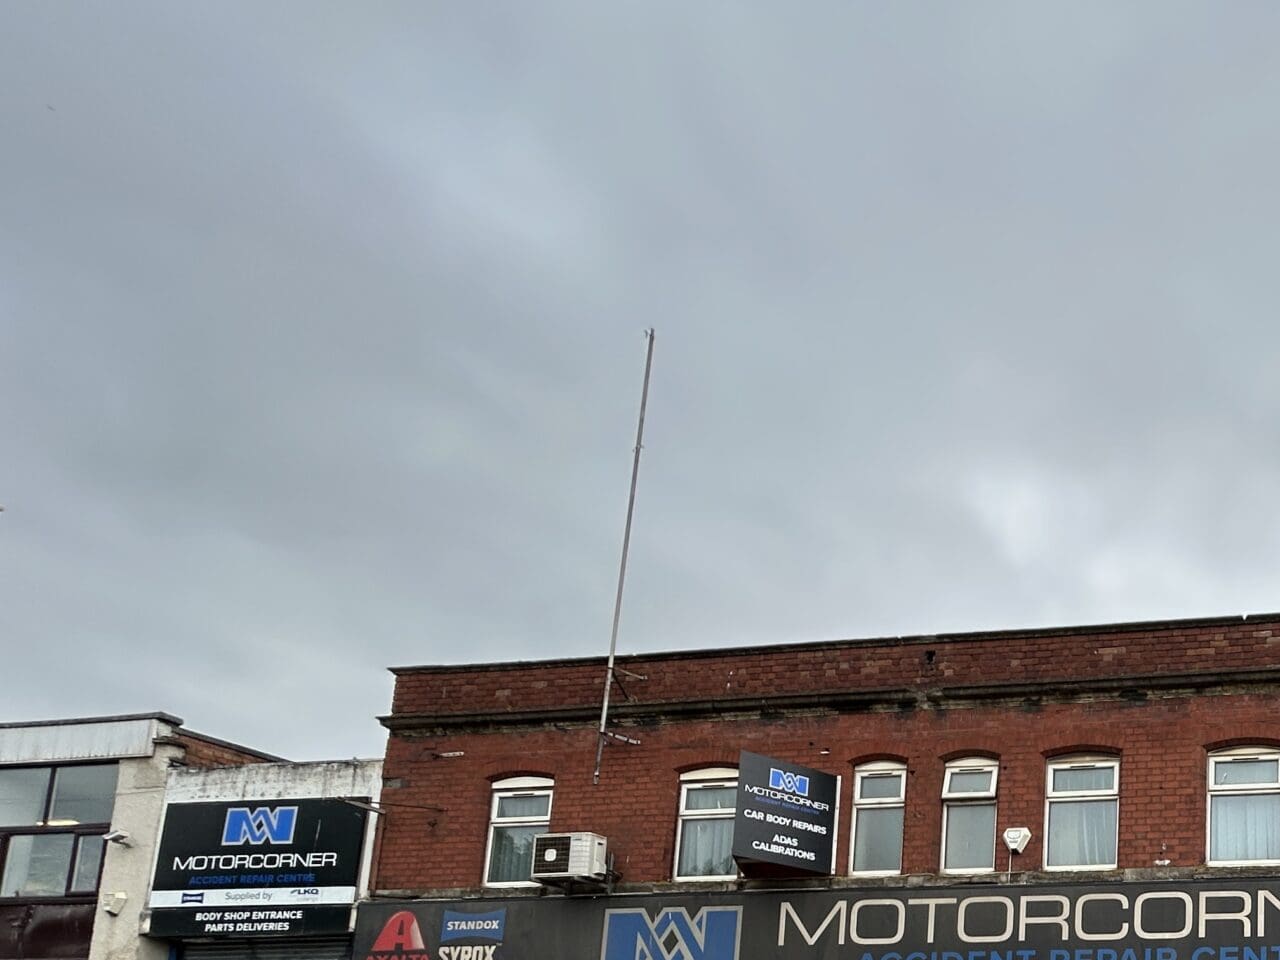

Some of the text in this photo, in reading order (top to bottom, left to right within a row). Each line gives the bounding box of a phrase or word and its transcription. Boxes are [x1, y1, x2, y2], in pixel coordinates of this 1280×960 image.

[744, 784, 829, 811] MOTORCORNER
[744, 809, 827, 835] CAR BODY REPAIRS
[772, 834, 798, 846] ADAS
[752, 841, 815, 861] CALIBRATIONS
[173, 852, 337, 871] MOTORCORNER
[189, 873, 315, 885] ACCIDENT REPAIR CENTRE
[225, 892, 273, 901] Supplied by
[195, 910, 303, 921] BODY SHOP ENTRANCE
[204, 922, 289, 932] PARTS DELIVERIES
[447, 920, 499, 930] STANDOX
